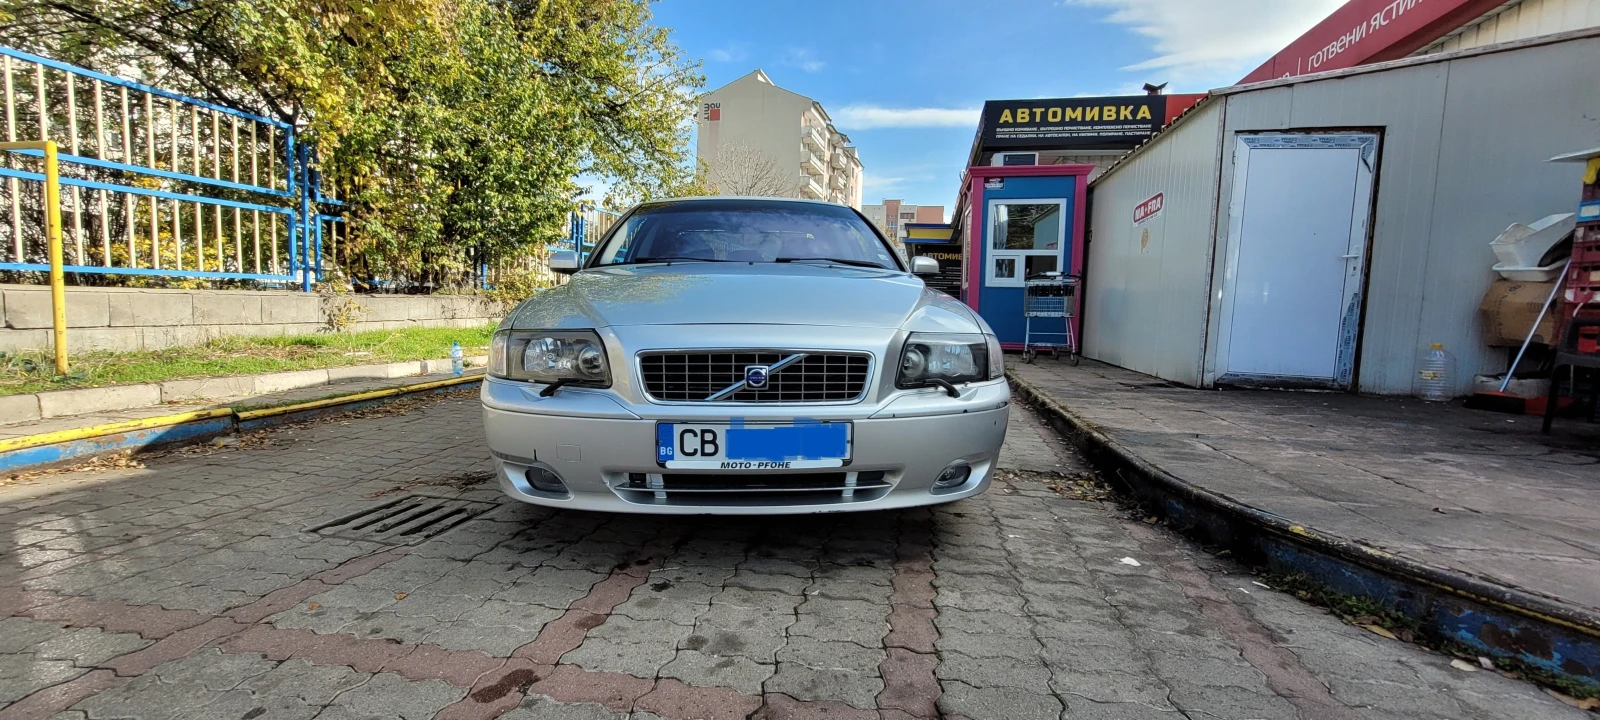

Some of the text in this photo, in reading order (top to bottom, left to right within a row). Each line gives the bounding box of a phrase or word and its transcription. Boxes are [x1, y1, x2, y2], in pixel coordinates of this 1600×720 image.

[999, 104, 1152, 123] АВТОМИВКА
[660, 428, 719, 457] BG CB
